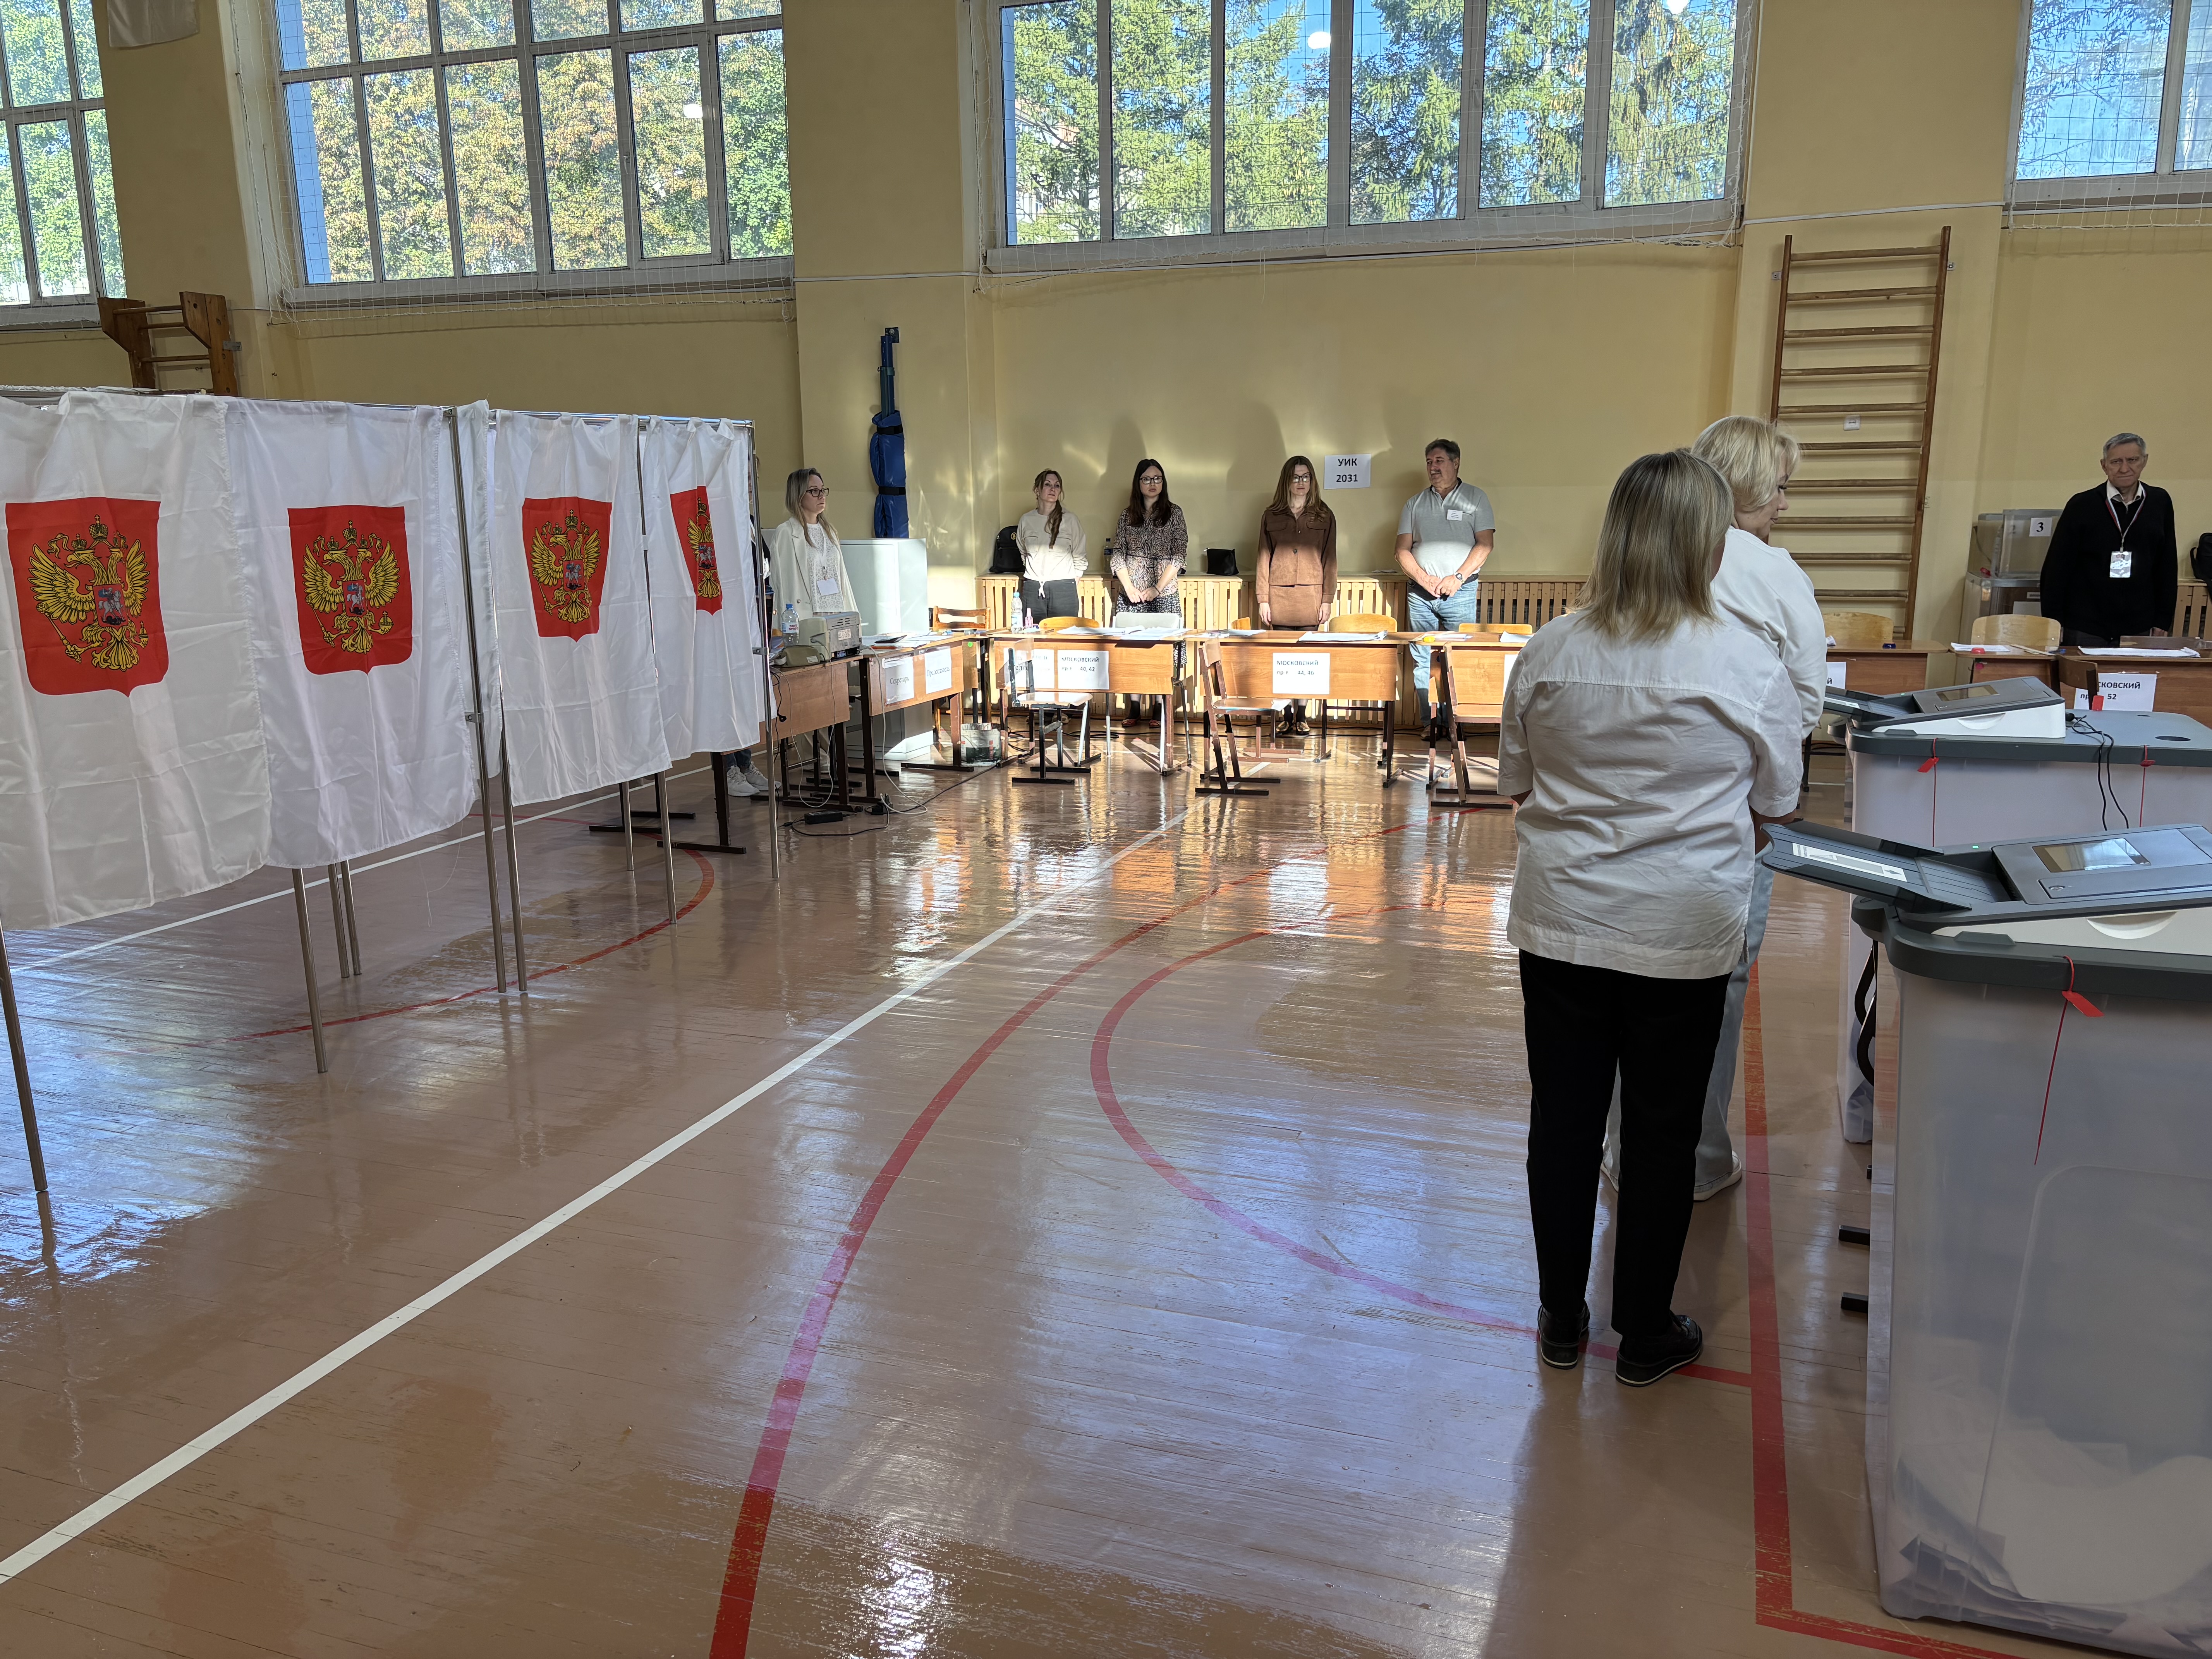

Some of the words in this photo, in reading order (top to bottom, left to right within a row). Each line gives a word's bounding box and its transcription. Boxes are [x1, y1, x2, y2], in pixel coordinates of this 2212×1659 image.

[1338, 458, 1357, 466] УИК
[1336, 474, 1358, 482] 2031
[2036, 522, 2044, 532] 3
